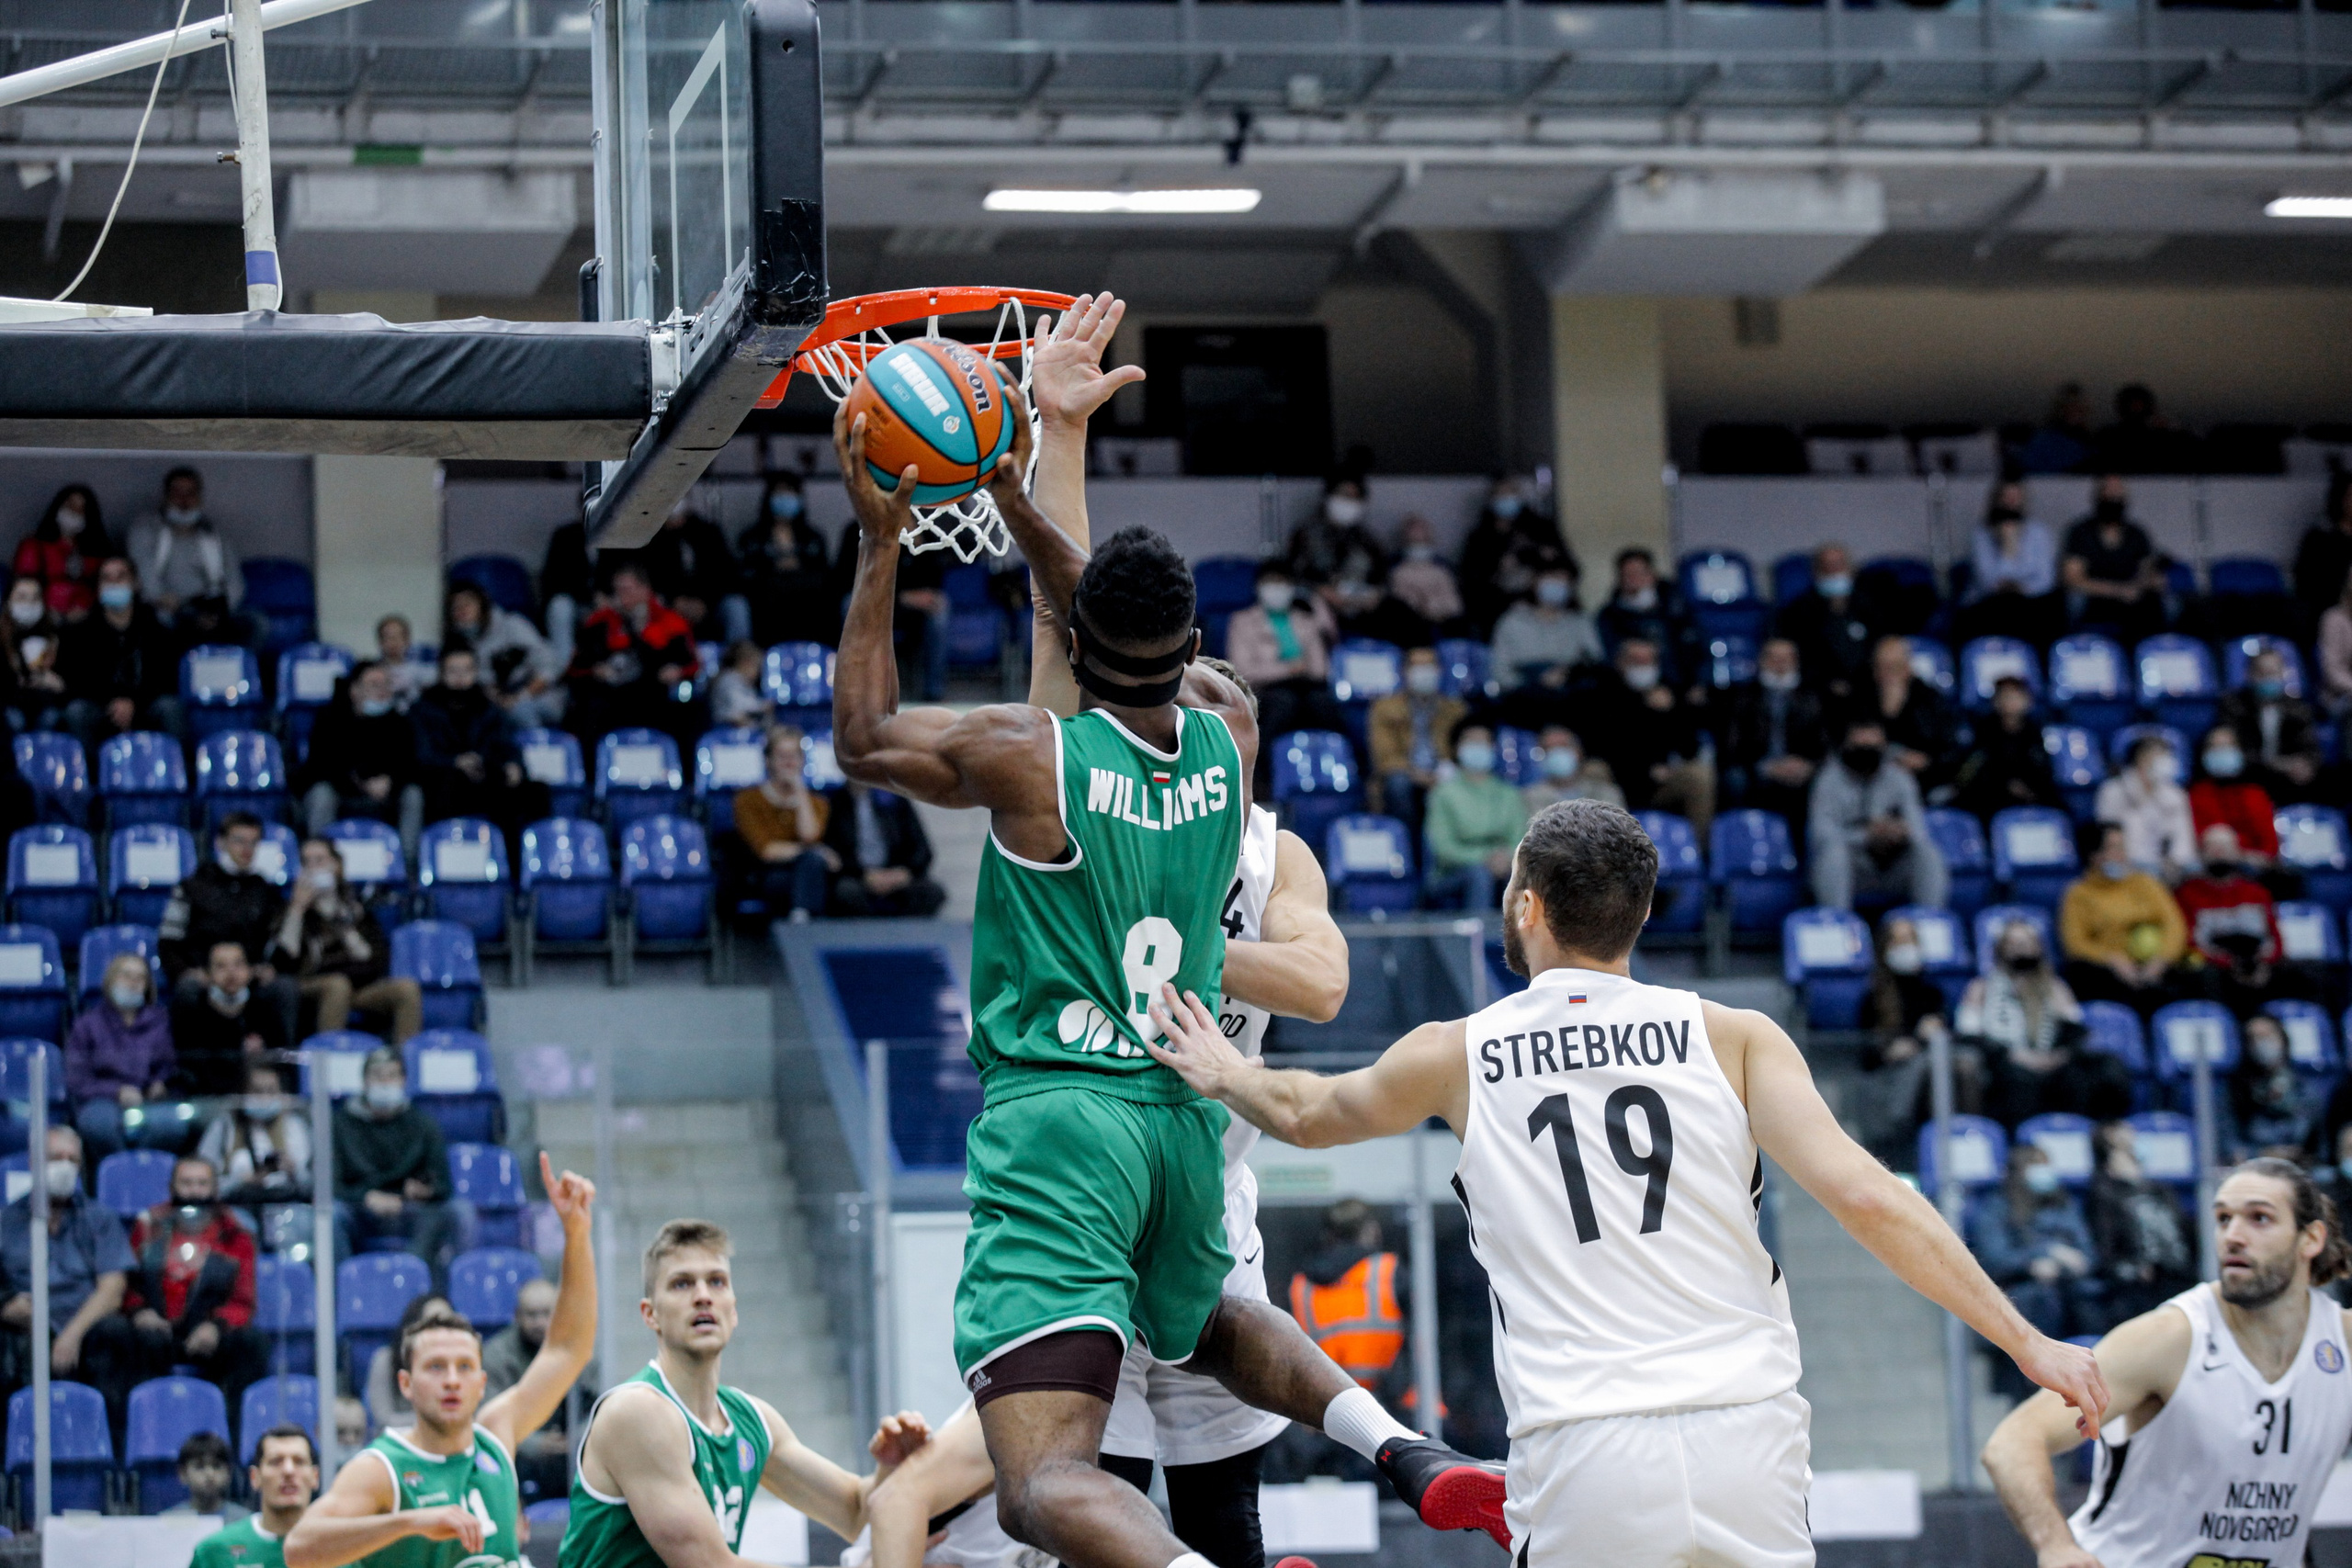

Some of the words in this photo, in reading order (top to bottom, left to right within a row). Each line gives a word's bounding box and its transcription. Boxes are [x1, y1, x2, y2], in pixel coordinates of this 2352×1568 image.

[1088, 765, 1227, 830] WILLIAMS
[1122, 916, 1183, 1043] 8
[1480, 1020, 1690, 1084] STREBKOV
[1527, 1084, 1674, 1244] 19
[2253, 1397, 2292, 1455] 31
[2224, 1481, 2298, 1509] NIZHNY
